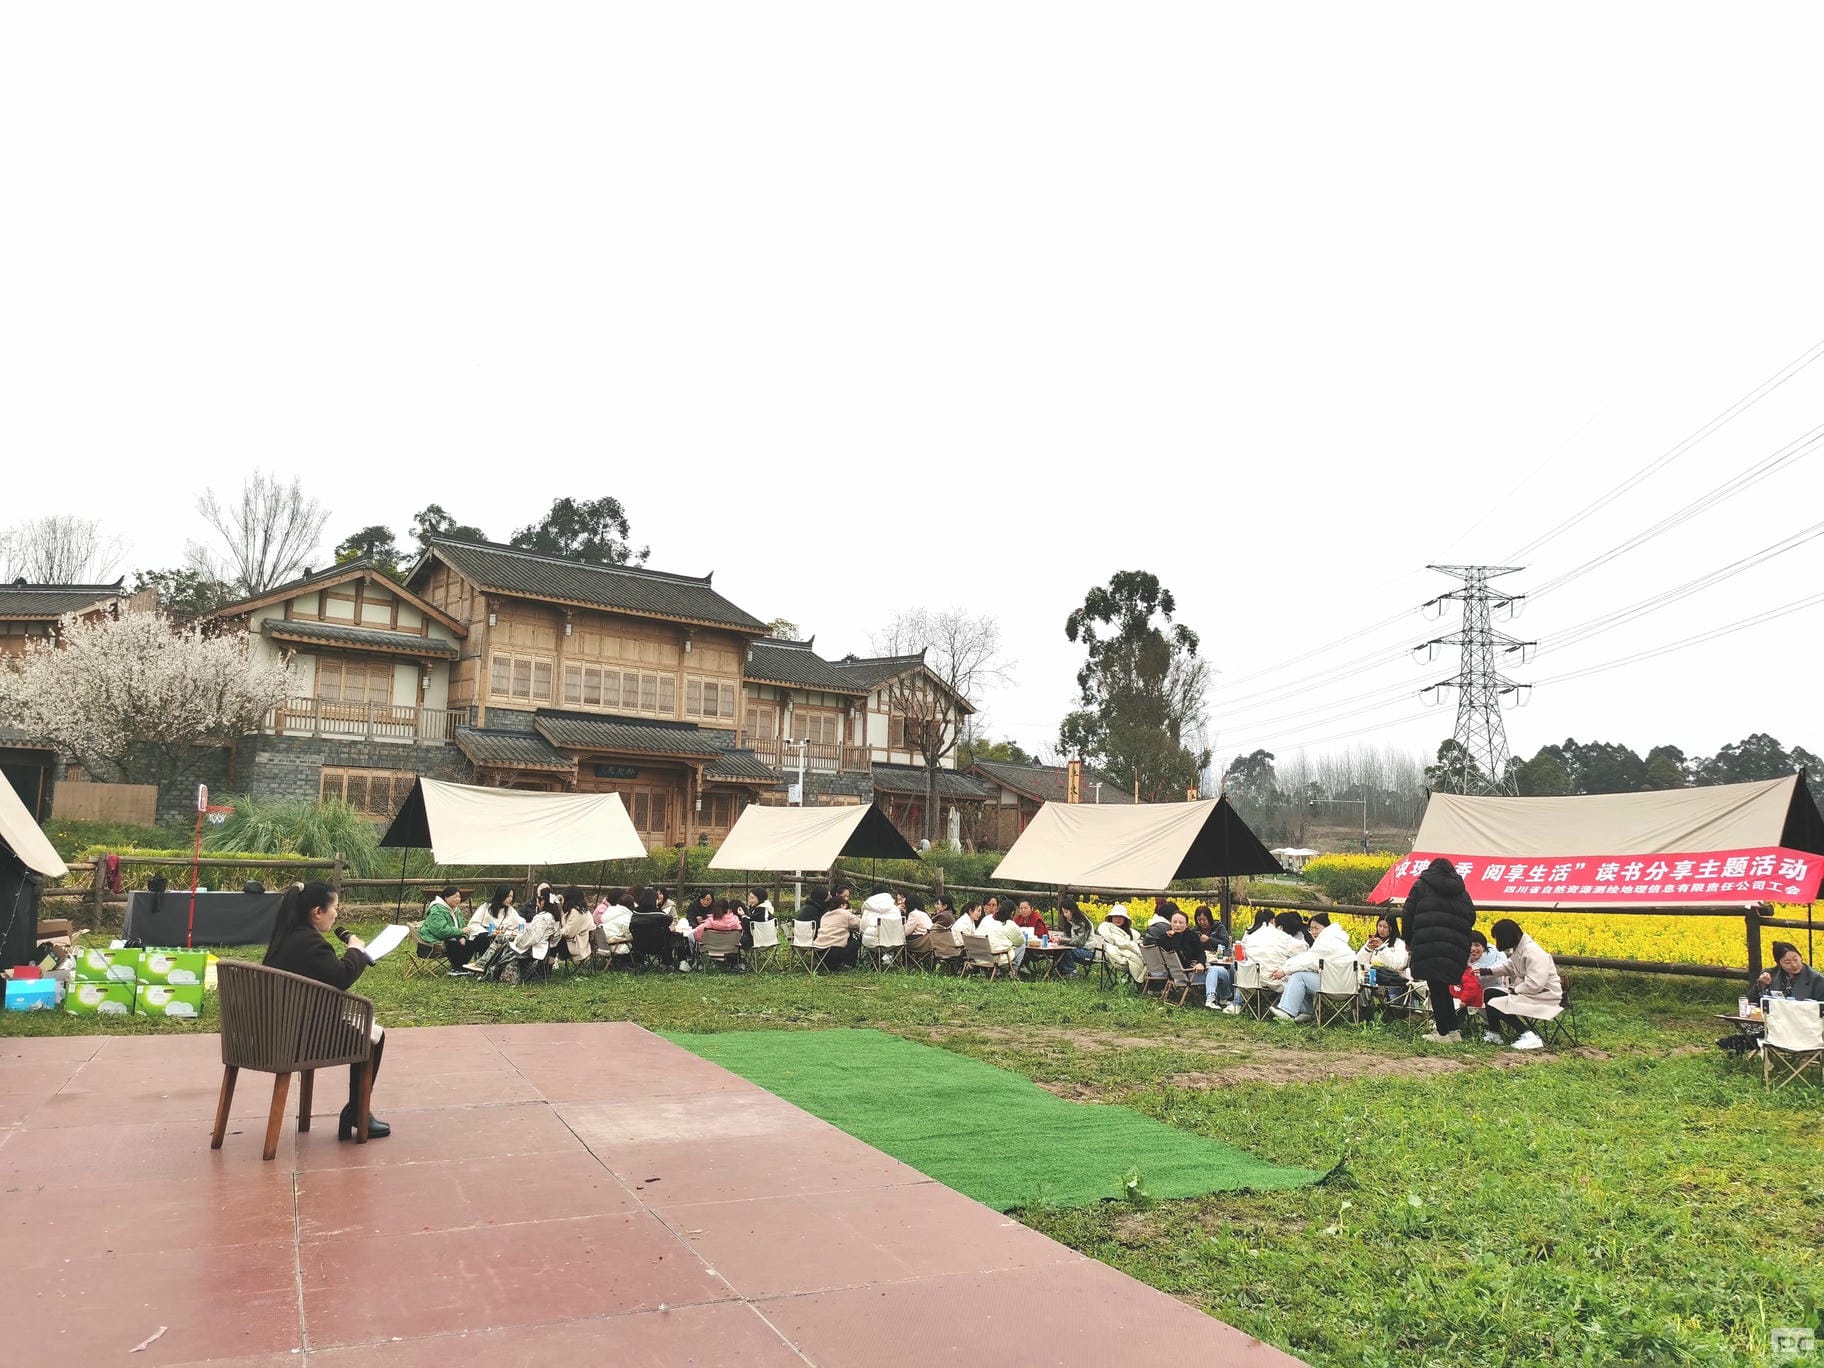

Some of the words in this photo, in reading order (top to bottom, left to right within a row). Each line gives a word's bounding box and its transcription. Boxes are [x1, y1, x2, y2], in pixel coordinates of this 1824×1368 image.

[1595, 855, 1808, 881] 读书分享主题活动
